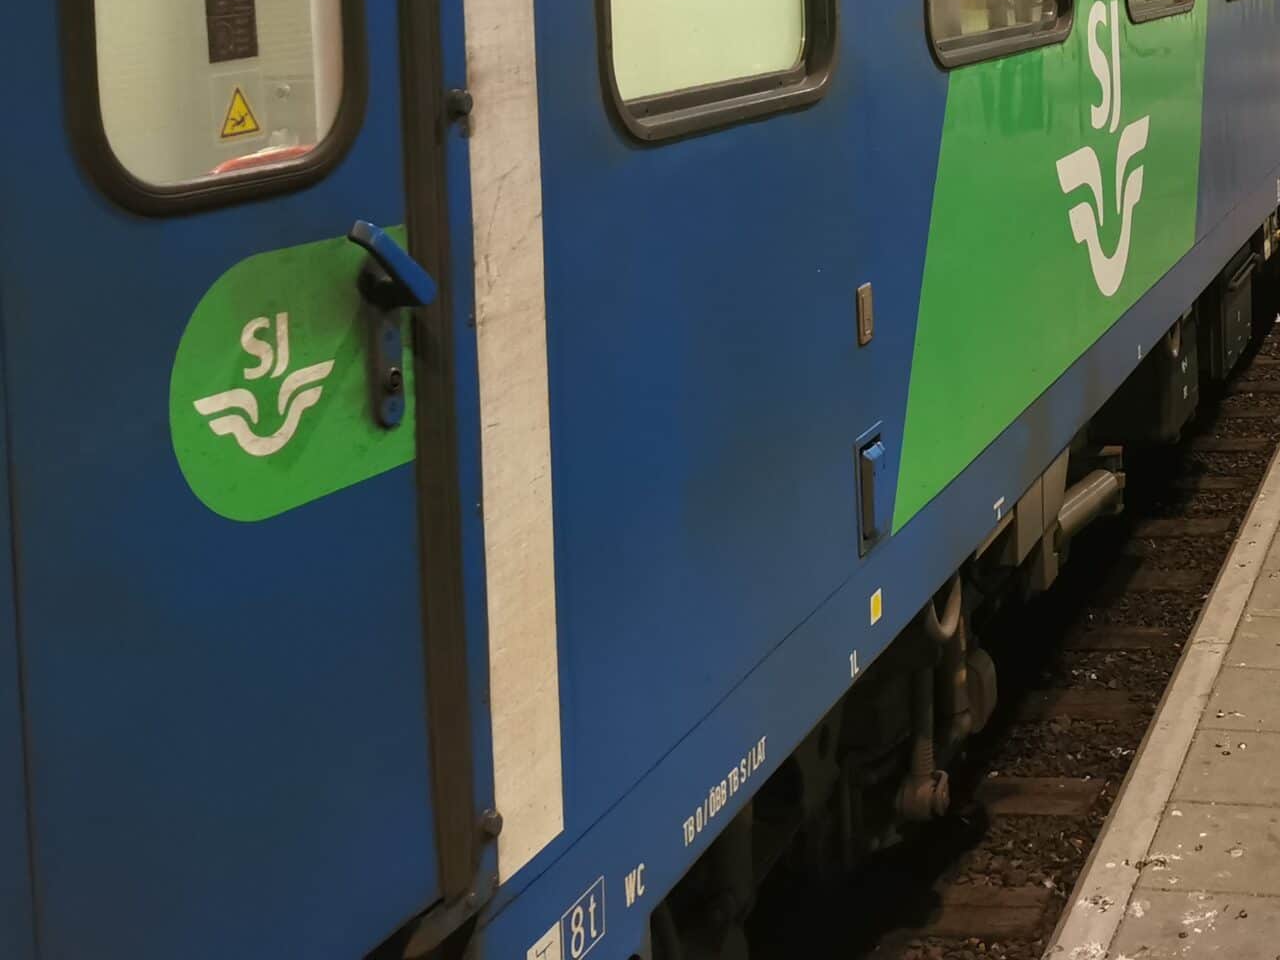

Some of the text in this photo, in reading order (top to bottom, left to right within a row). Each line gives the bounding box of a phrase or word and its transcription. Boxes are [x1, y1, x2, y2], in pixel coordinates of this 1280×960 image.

[1087, 0, 1121, 134] SJ
[241, 311, 290, 380] SJ
[727, 766, 740, 797] TB
[740, 758, 747, 783] S
[624, 863, 645, 908] WC
